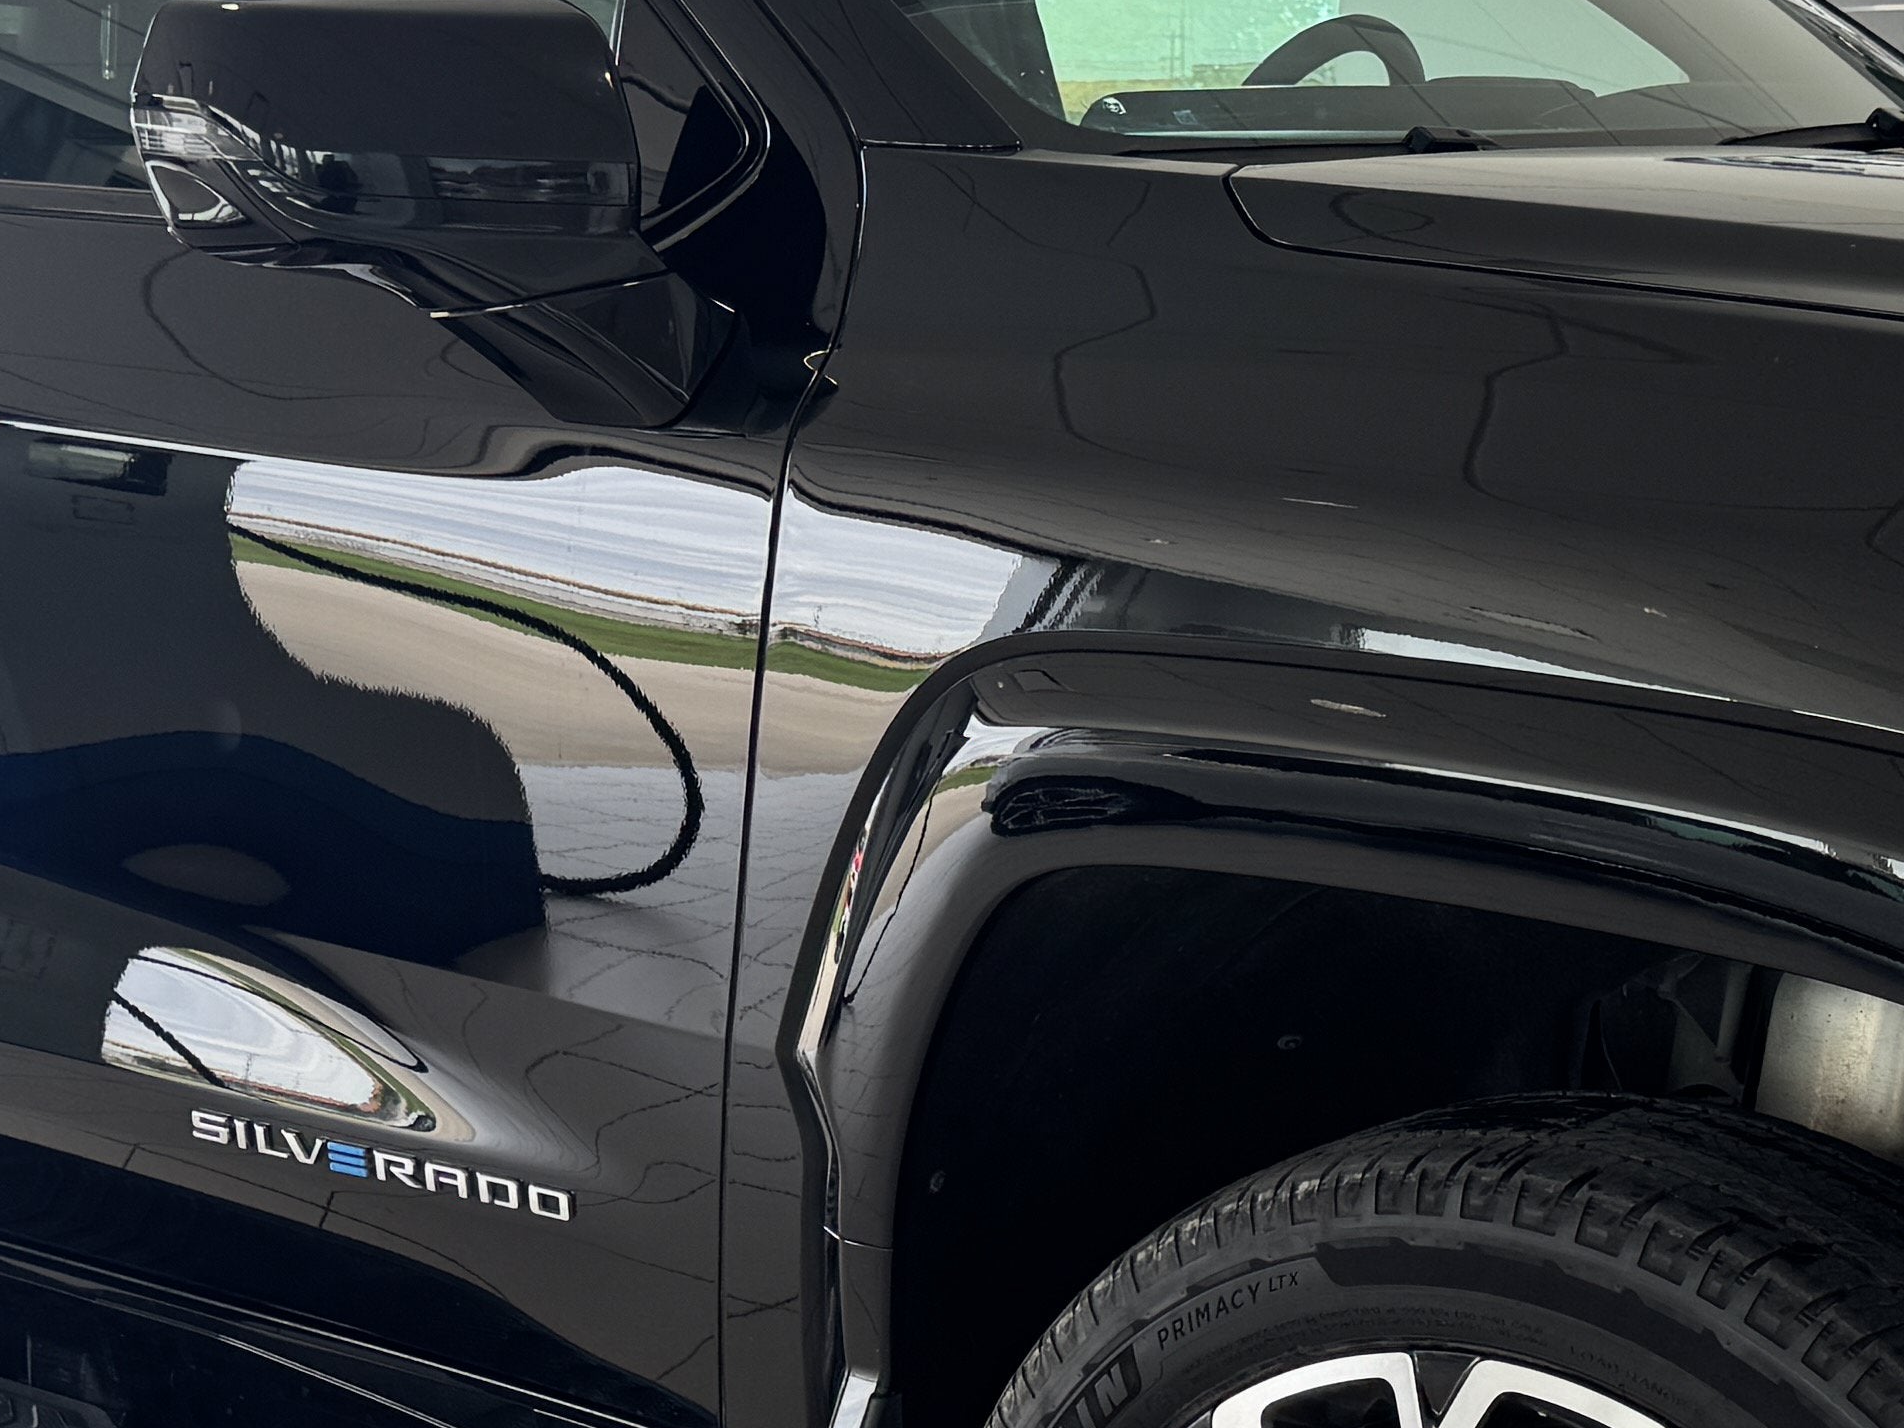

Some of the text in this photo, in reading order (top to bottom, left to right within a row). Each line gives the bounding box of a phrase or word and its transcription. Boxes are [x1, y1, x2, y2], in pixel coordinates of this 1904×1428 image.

[191, 1109, 574, 1222] SILVERADO
[1156, 1280, 1262, 1351] PRIMACY
[1266, 1270, 1300, 1294] LTX
